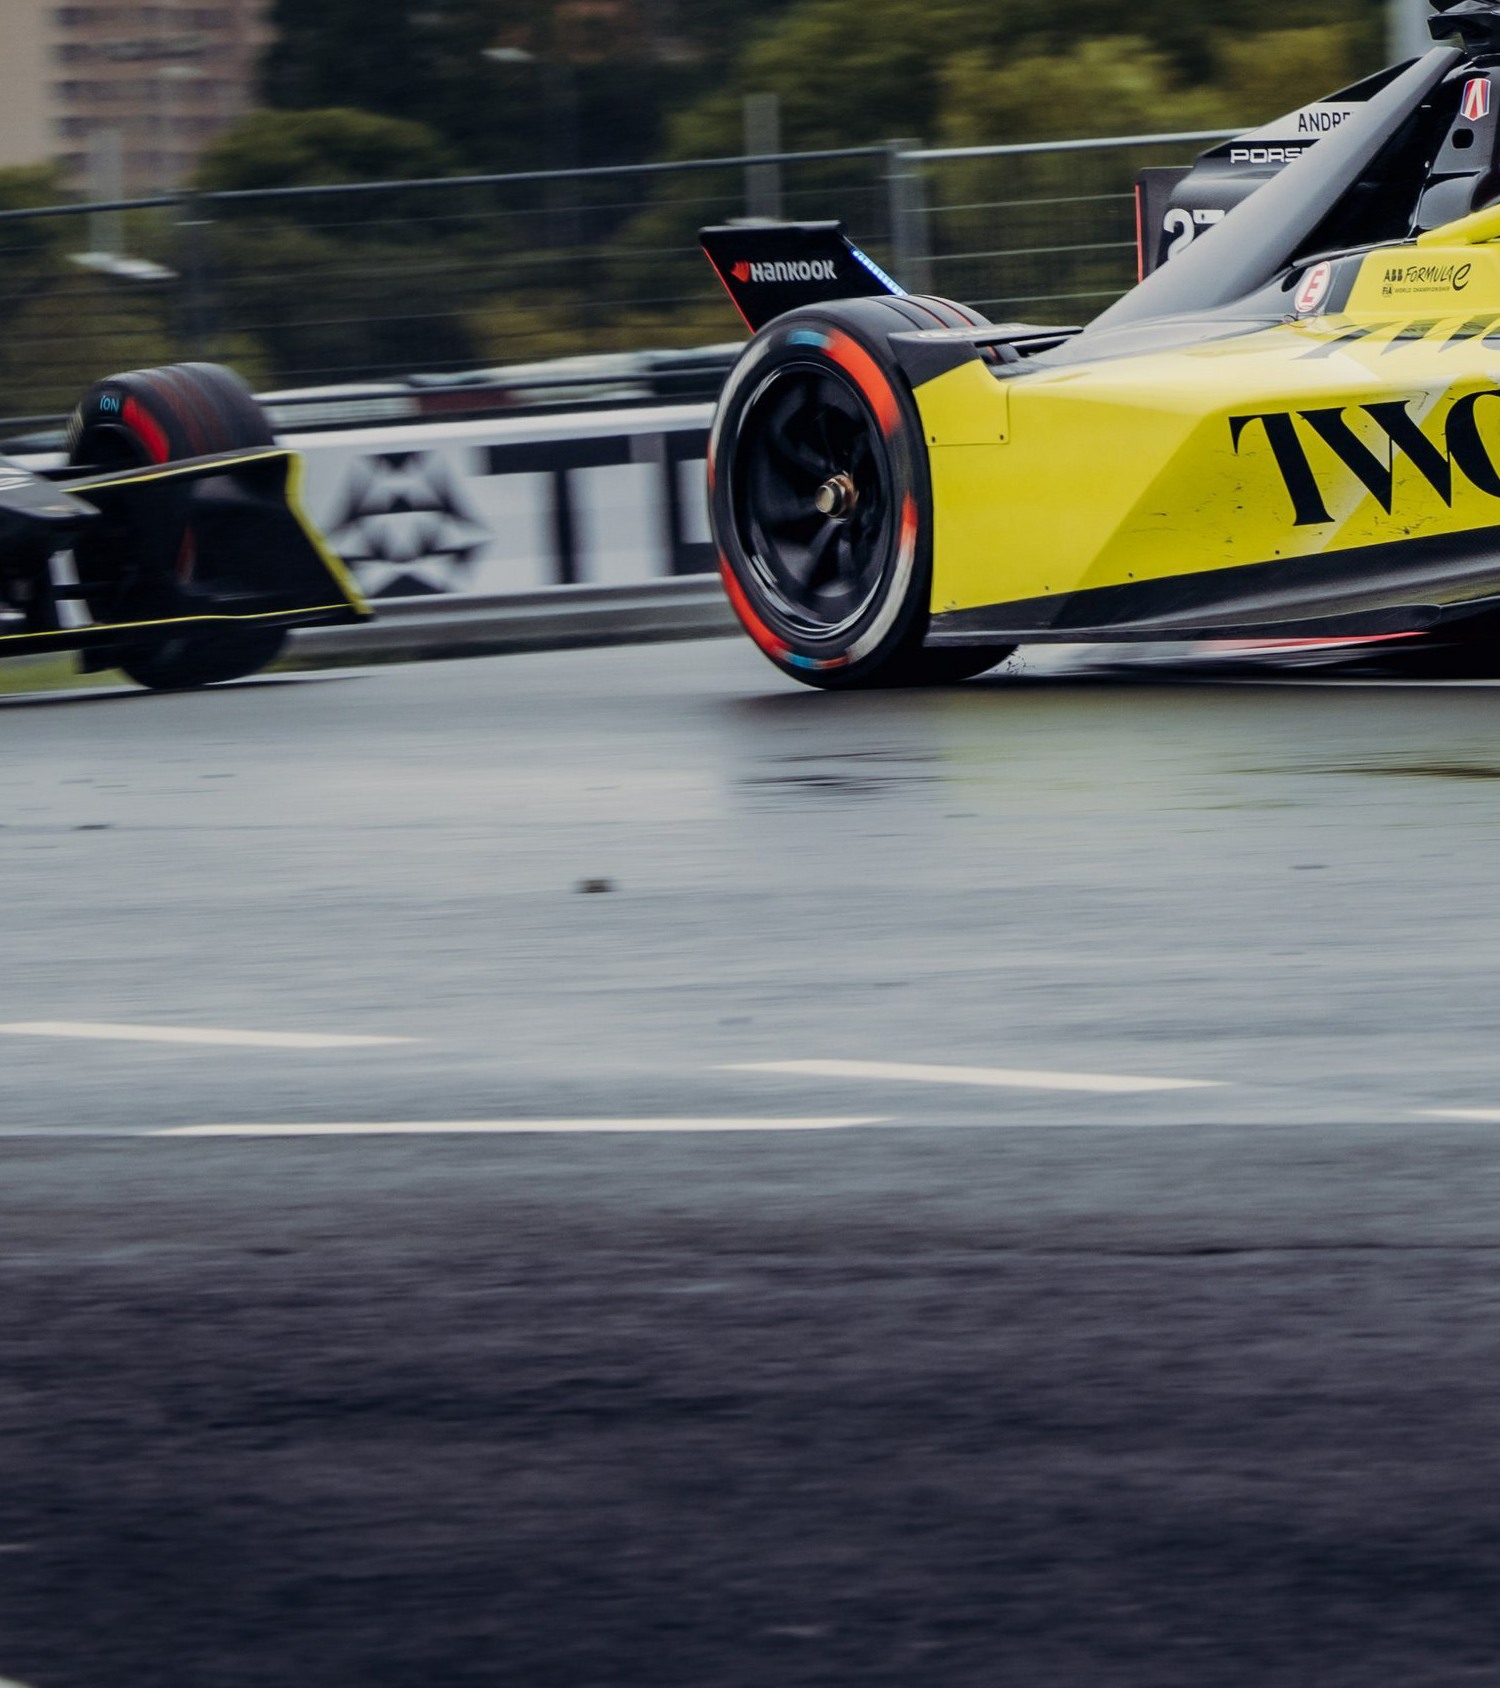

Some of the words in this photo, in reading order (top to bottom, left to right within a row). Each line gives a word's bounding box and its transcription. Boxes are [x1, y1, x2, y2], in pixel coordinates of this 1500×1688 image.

[1230, 148, 1308, 163] PORS
[1384, 268, 1403, 282] ABB
[1404, 265, 1454, 284] FORMULA
